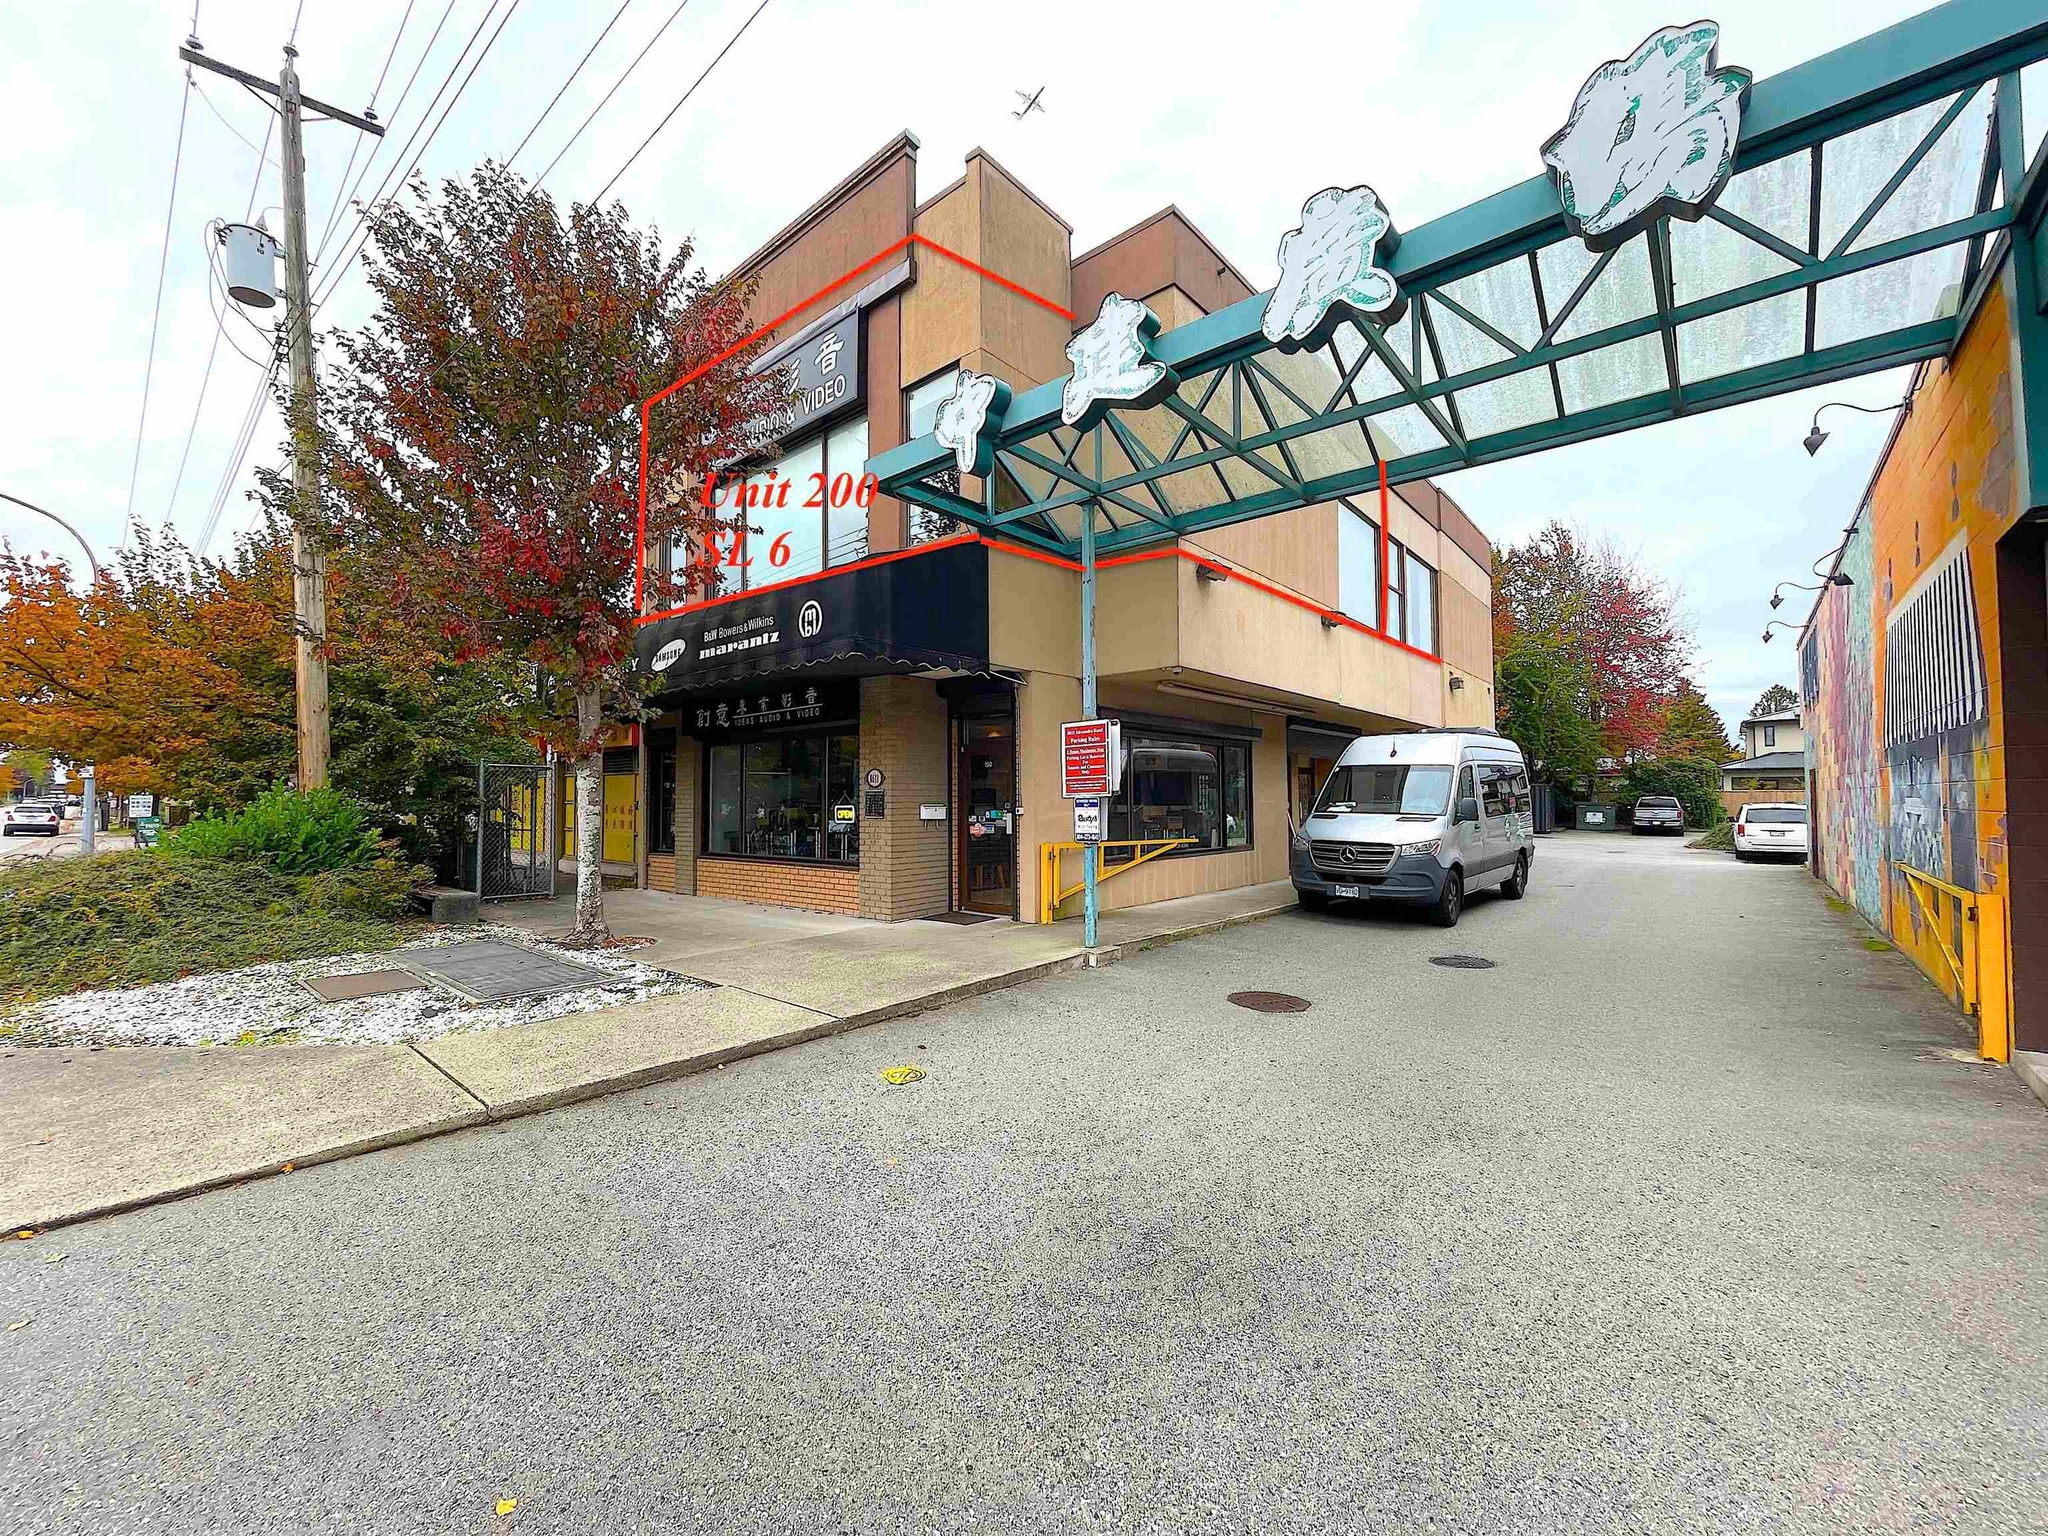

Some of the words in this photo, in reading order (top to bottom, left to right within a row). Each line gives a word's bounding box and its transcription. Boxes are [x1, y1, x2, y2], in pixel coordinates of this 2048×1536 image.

[801, 373, 847, 415] VIDEO
[698, 630, 780, 660] marantz
[734, 716, 754, 727] IDEAS
[759, 712, 781, 723] AUDIO
[786, 712, 791, 720] &
[796, 707, 820, 719] VIDEO
[837, 809, 854, 820] OPEN
